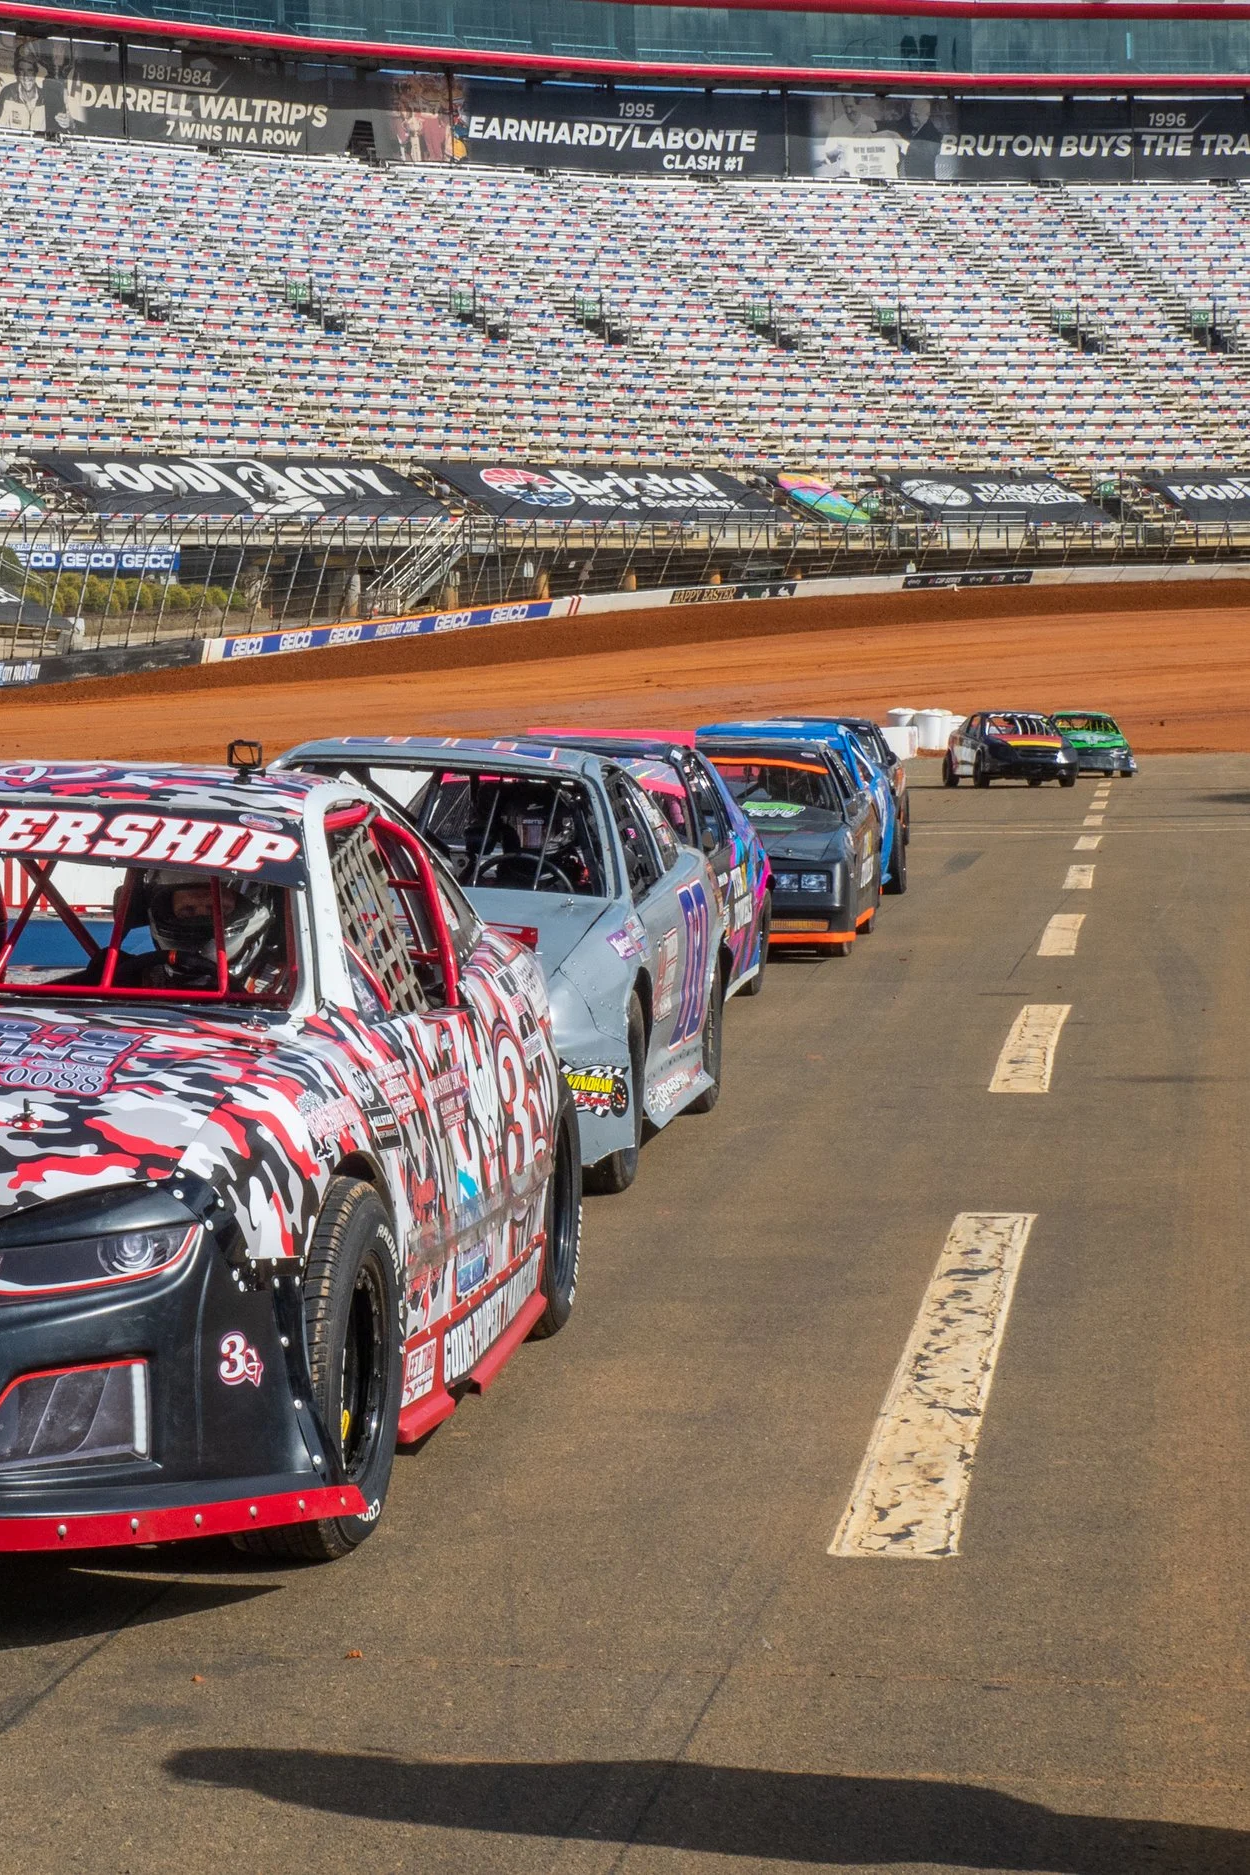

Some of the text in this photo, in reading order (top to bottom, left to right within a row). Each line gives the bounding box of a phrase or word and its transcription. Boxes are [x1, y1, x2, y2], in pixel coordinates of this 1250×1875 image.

[141, 64, 212, 85] 1981-1984
[80, 83, 328, 128] DARRELL WALTRIP'S
[618, 102, 655, 118] 1995
[1148, 112, 1187, 127] 1996
[166, 120, 302, 147] 7 WINS IN A ROW
[468, 116, 757, 152] EARNHARDT/LABONTE
[940, 134, 1250, 157] BRUTON BUYS THE TRA
[662, 154, 743, 171] CLASH #1
[75, 462, 398, 496] FOOD CITY
[549, 470, 727, 499] Bristol
[971, 483, 1062, 495] TRACKER
[1167, 484, 1245, 500] FOOD
[672, 587, 737, 603] HAPPY EASTER
[434, 612, 472, 631] GEICO
[490, 604, 528, 622] GEICO
[329, 625, 362, 645] GEICO
[375, 619, 422, 637] RESTART ZONE
[231, 637, 263, 657] GEICO
[279, 631, 312, 651] GEICO
[564, 1073, 613, 1093] WINDHAM
[219, 1331, 263, 1387] 3G
